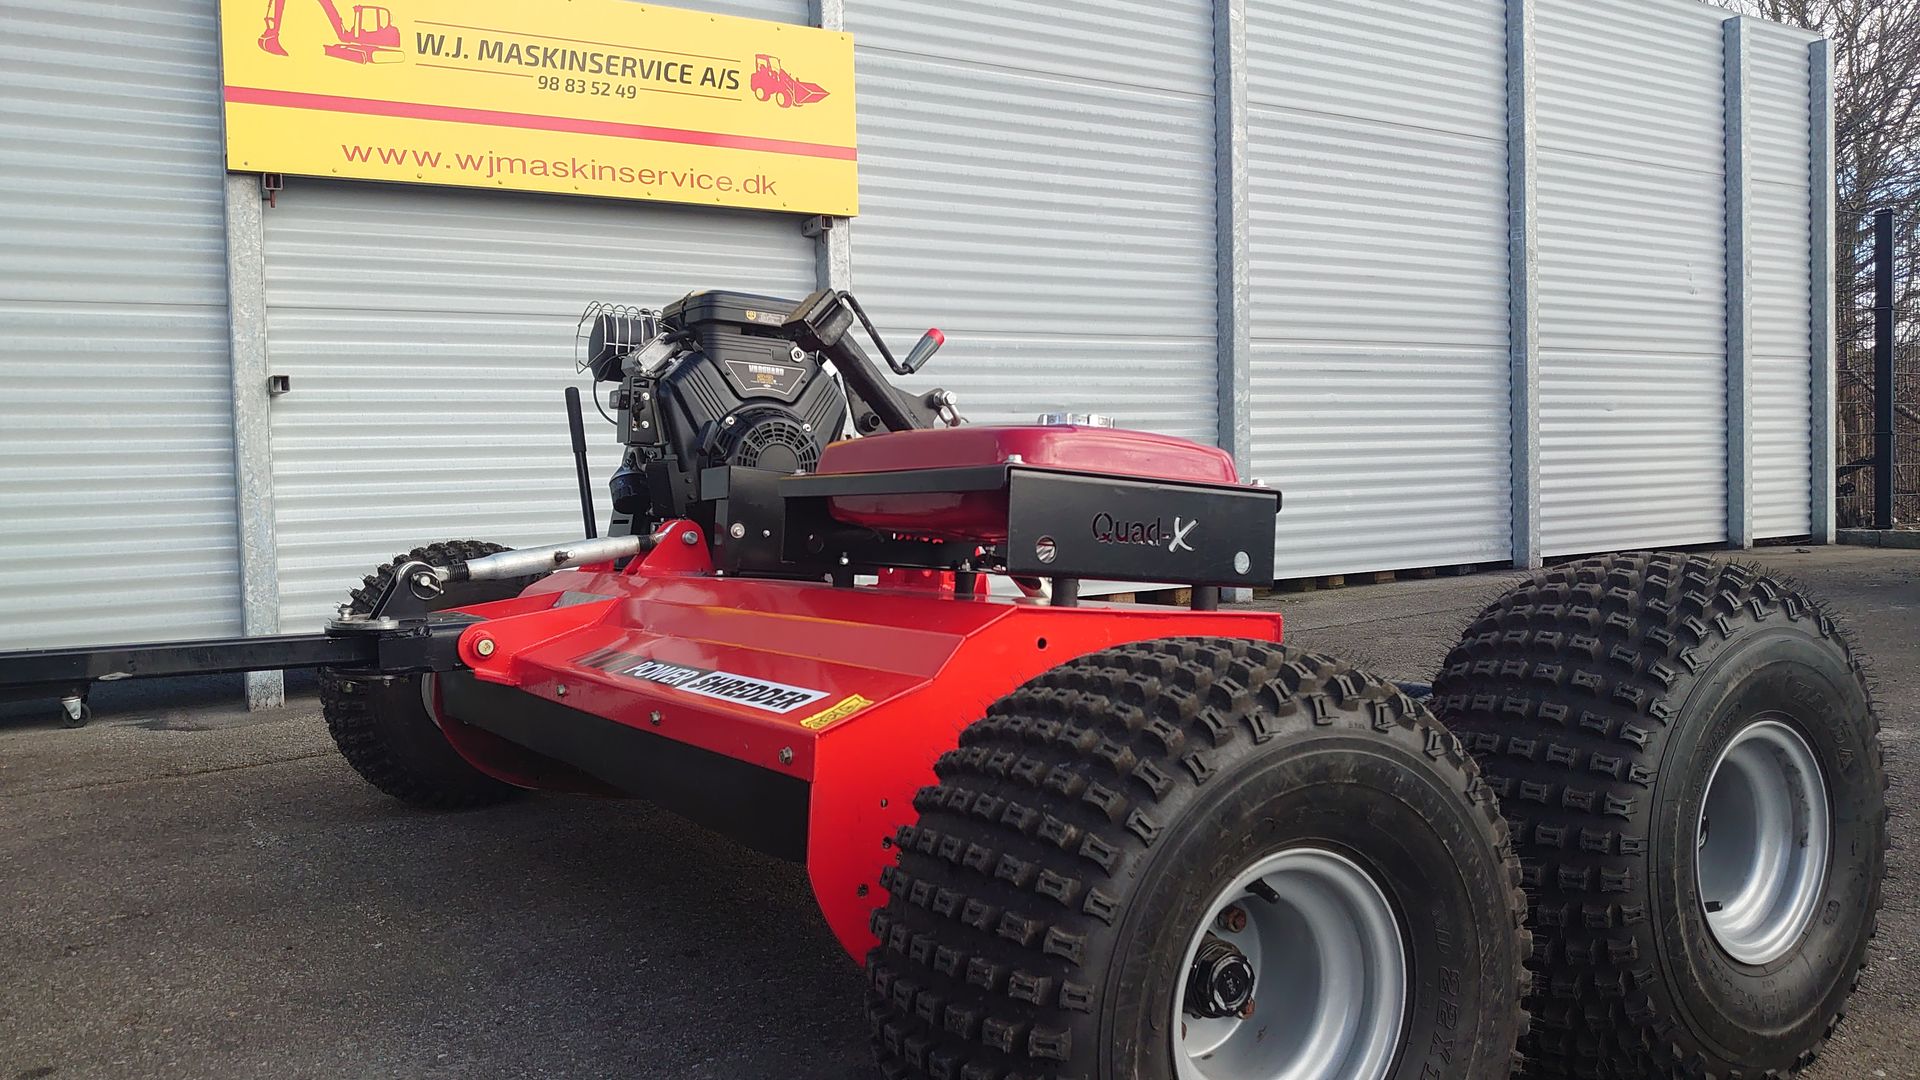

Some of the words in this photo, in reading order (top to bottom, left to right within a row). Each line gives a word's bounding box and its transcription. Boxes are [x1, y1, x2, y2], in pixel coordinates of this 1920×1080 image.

[416, 32, 469, 59] W.J.
[477, 39, 694, 85] MASKINSERVICE
[700, 67, 741, 91] A/S
[537, 75, 560, 91] 98
[564, 77, 587, 94] 83
[590, 81, 611, 97] 52
[615, 84, 637, 99] 49
[341, 143, 778, 197] www.wjmaskinservice.dk
[623, 661, 700, 686] POWER
[687, 675, 812, 710] SHREDDER
